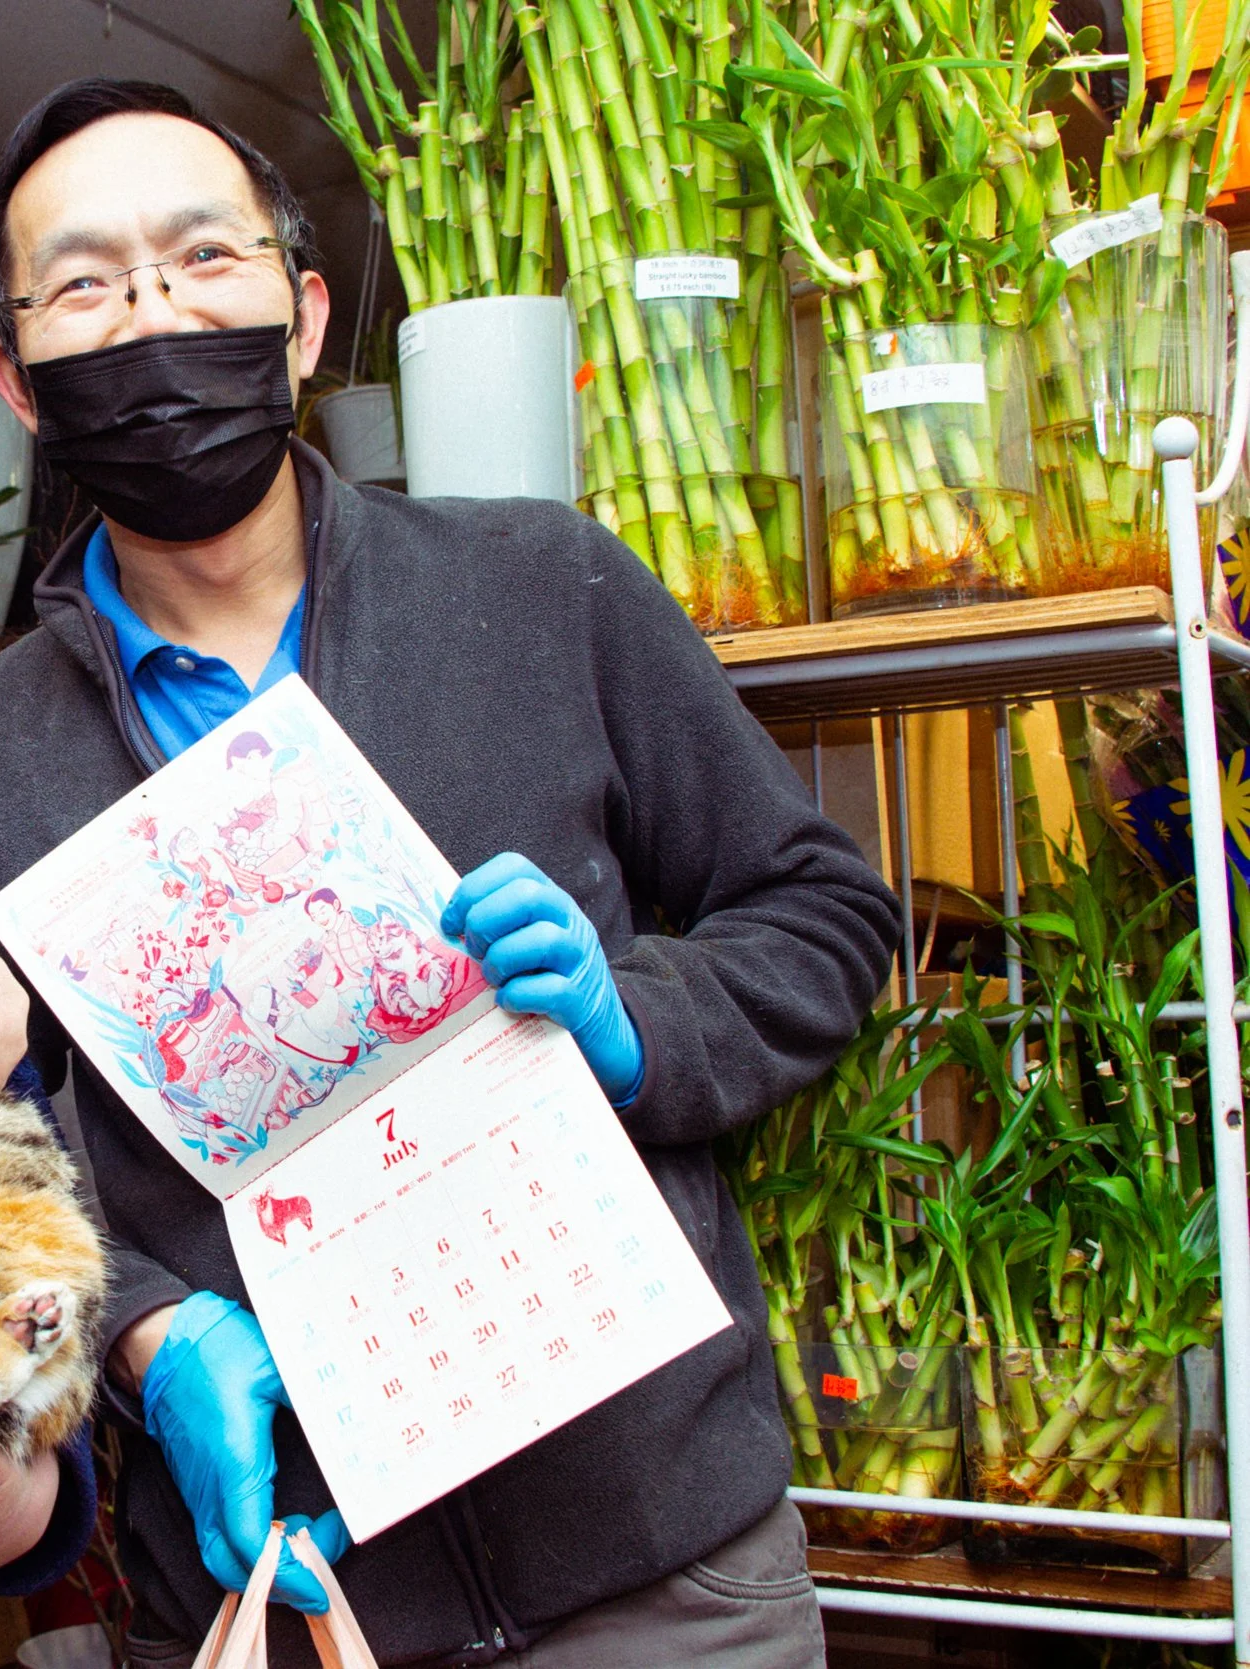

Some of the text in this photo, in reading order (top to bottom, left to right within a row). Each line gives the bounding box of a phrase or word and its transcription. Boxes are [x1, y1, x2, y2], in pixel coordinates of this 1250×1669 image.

[648, 273, 677, 281] Straight
[477, 1034, 503, 1054] FLORIST
[376, 1108, 396, 1142] 7
[383, 1140, 418, 1170] July
[511, 1110, 567, 1154] 1 2
[329, 1227, 345, 1240] MON
[374, 1200, 387, 1211] TUE
[416, 1171, 432, 1183] WED
[462, 1143, 476, 1154] THU
[303, 1152, 589, 1338] 3 4 5 6 7 8 9
[317, 1193, 616, 1383] 10 11 12 13 14 15 16
[336, 1234, 641, 1426] 17 18 19 20 21 22 23
[401, 1422, 425, 1445] 25
[448, 1394, 472, 1418] 26
[496, 1365, 517, 1389] 27
[544, 1337, 569, 1361] 28
[592, 1308, 616, 1332] 29
[640, 1280, 666, 1304] 30
